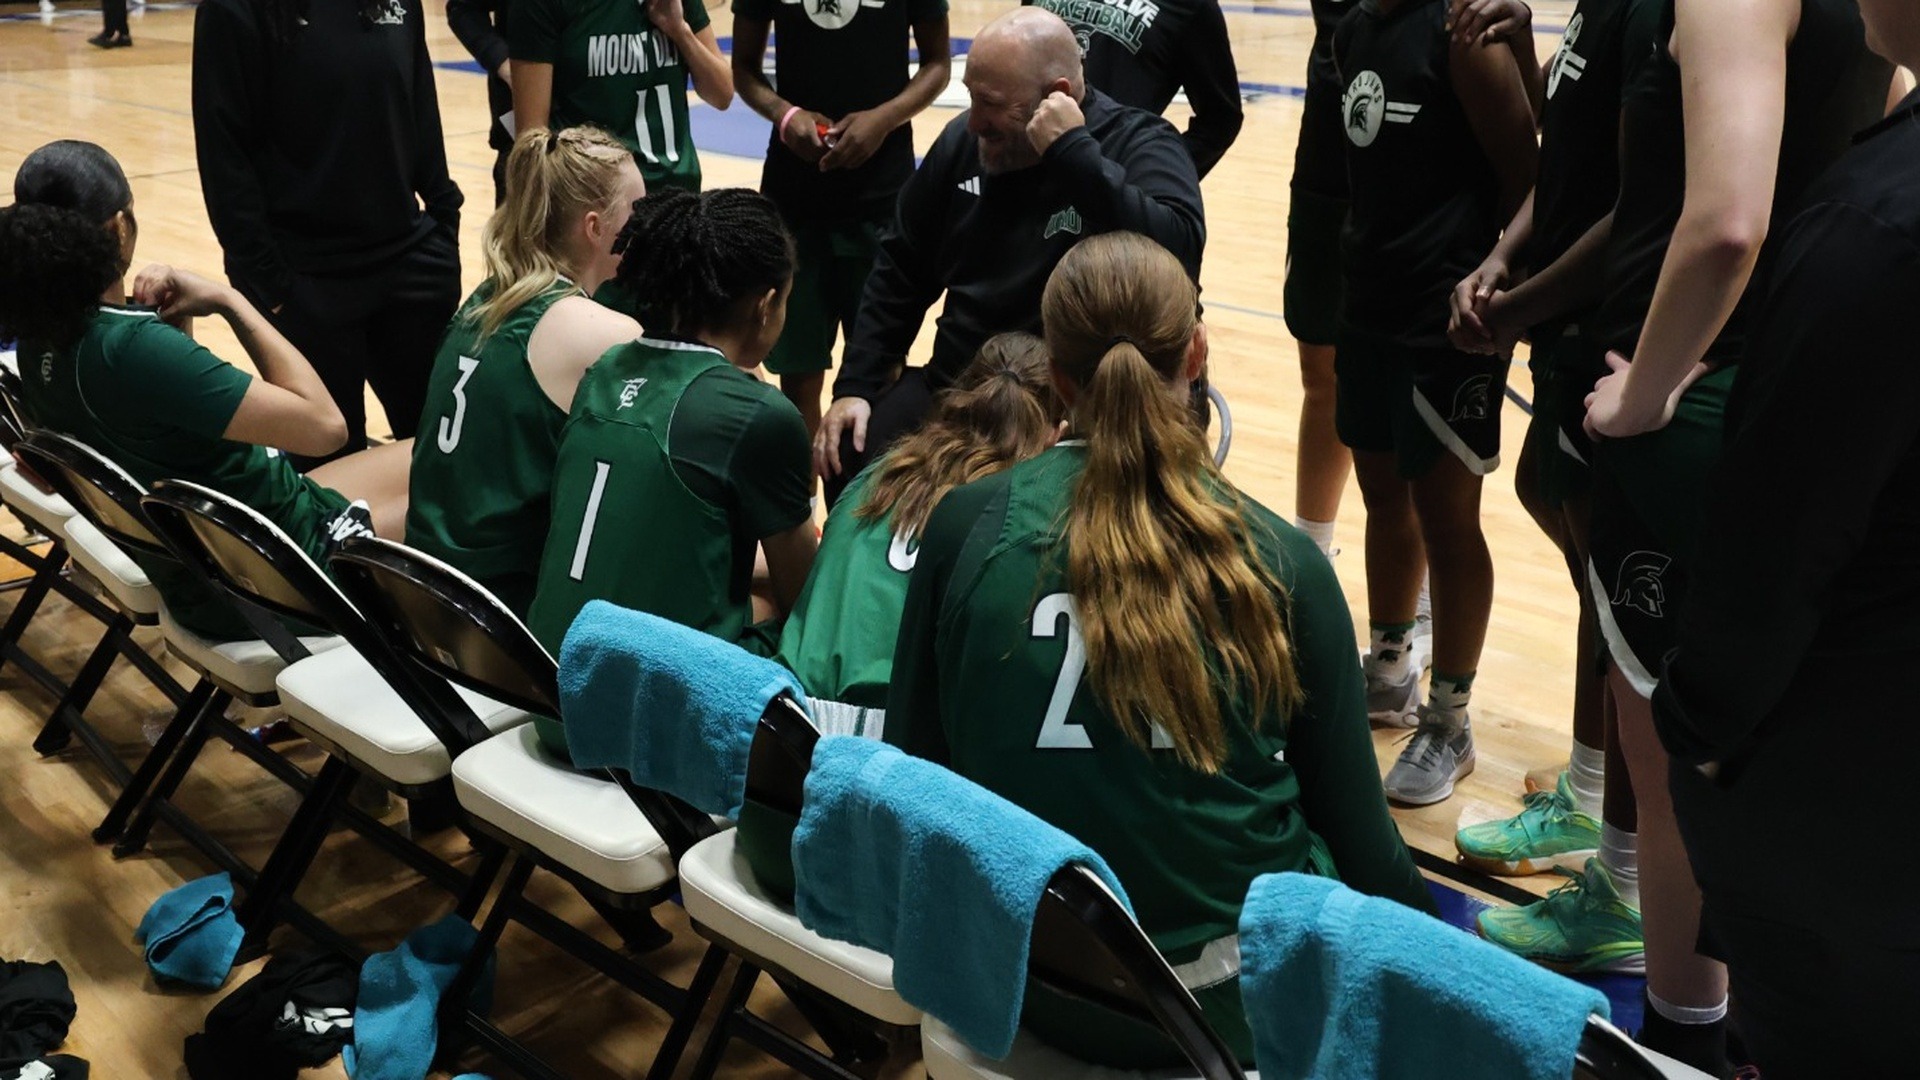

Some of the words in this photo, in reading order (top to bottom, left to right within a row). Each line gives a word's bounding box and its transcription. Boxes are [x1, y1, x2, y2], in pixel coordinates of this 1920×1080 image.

[1032, 0, 1143, 51] SKETBALL
[1104, 0, 1160, 28] LIVE
[587, 31, 648, 77] MOUNT
[635, 84, 679, 163] 11
[437, 355, 480, 454] 3
[569, 461, 611, 581] 1
